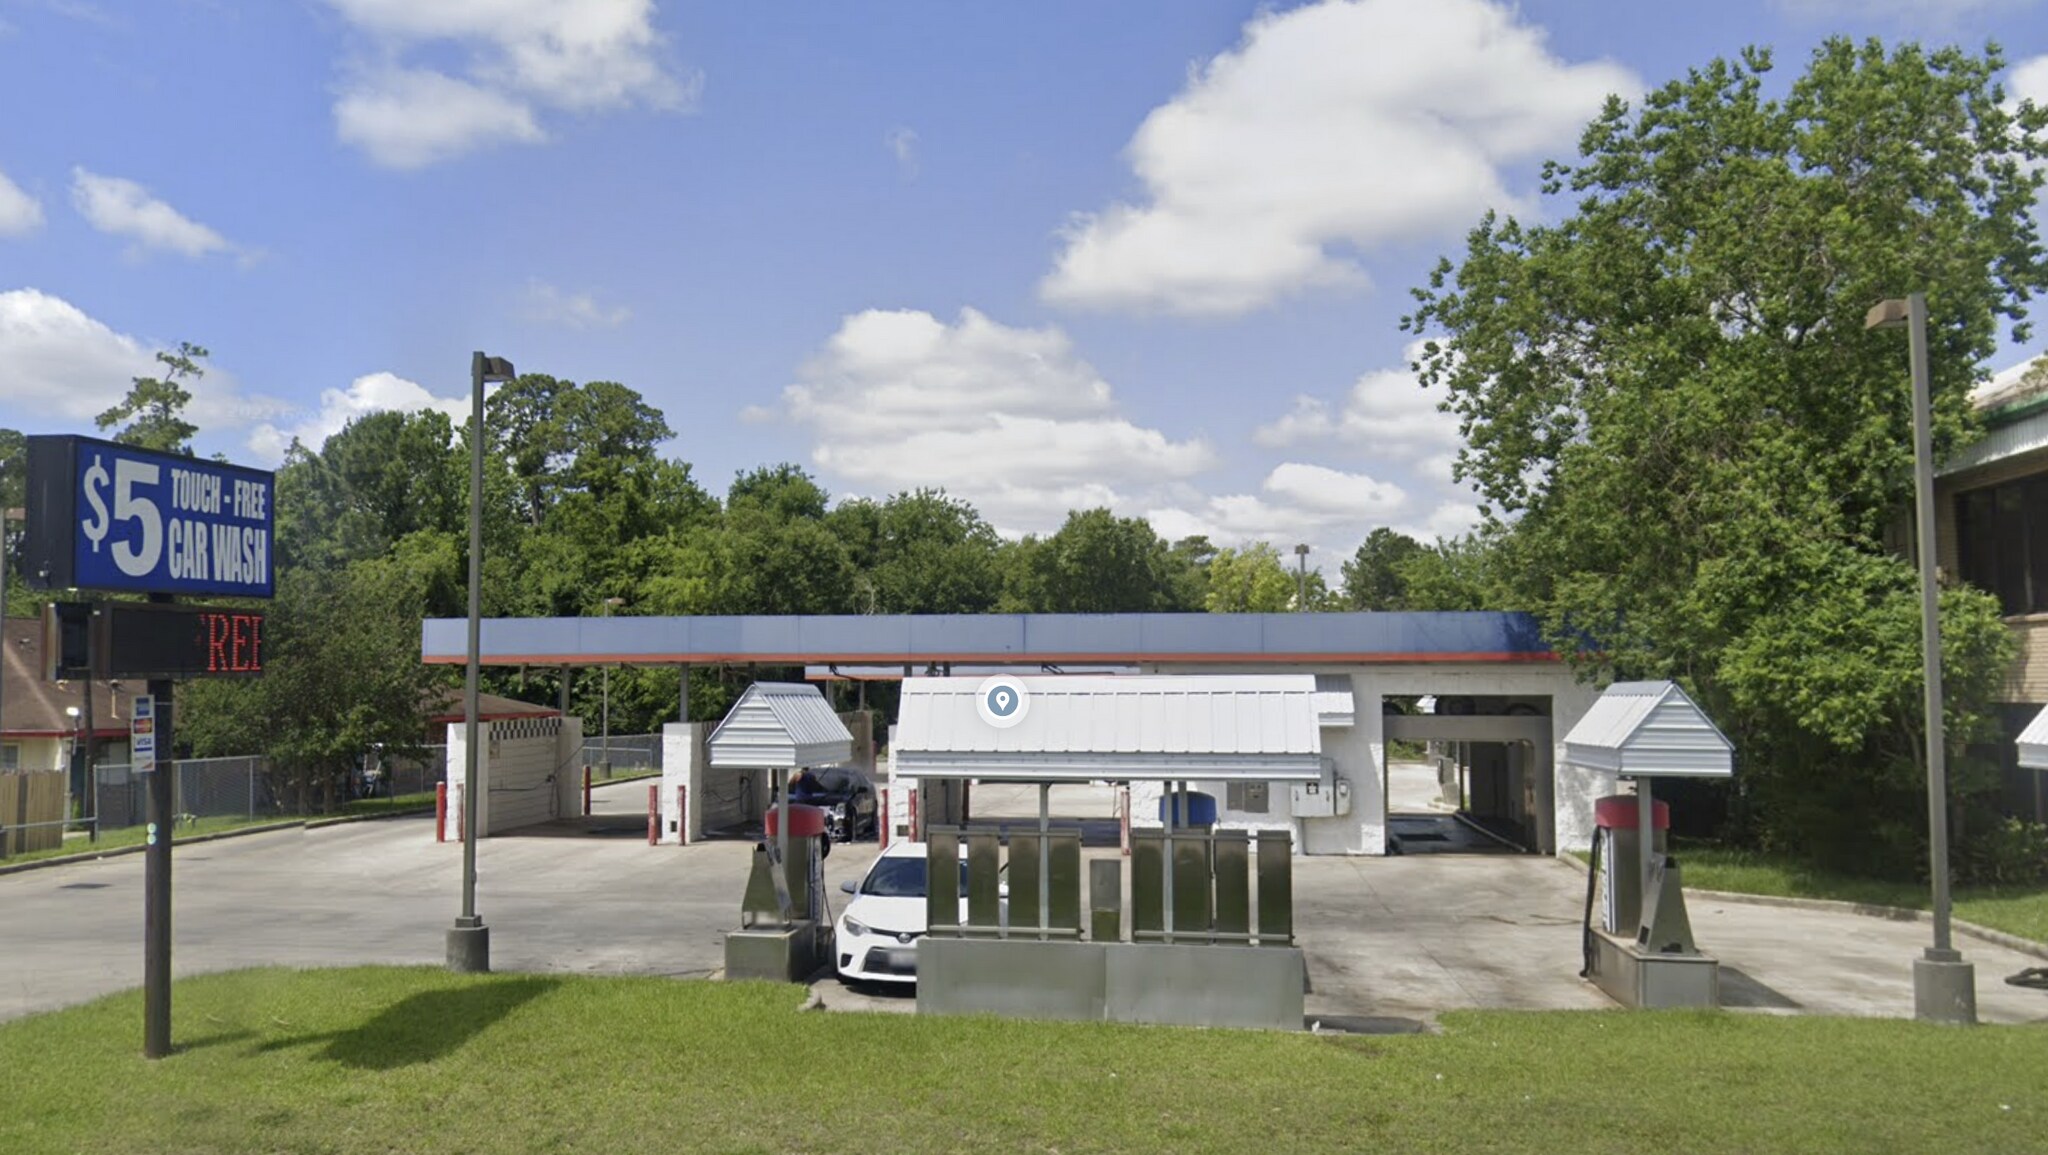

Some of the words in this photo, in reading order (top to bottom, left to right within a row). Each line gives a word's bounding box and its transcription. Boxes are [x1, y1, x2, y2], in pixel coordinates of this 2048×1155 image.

[82, 454, 163, 577] $5
[171, 468, 221, 514] TOUCH
[234, 479, 266, 520] FREE
[168, 518, 208, 580] CAR
[212, 524, 267, 584] WASH
